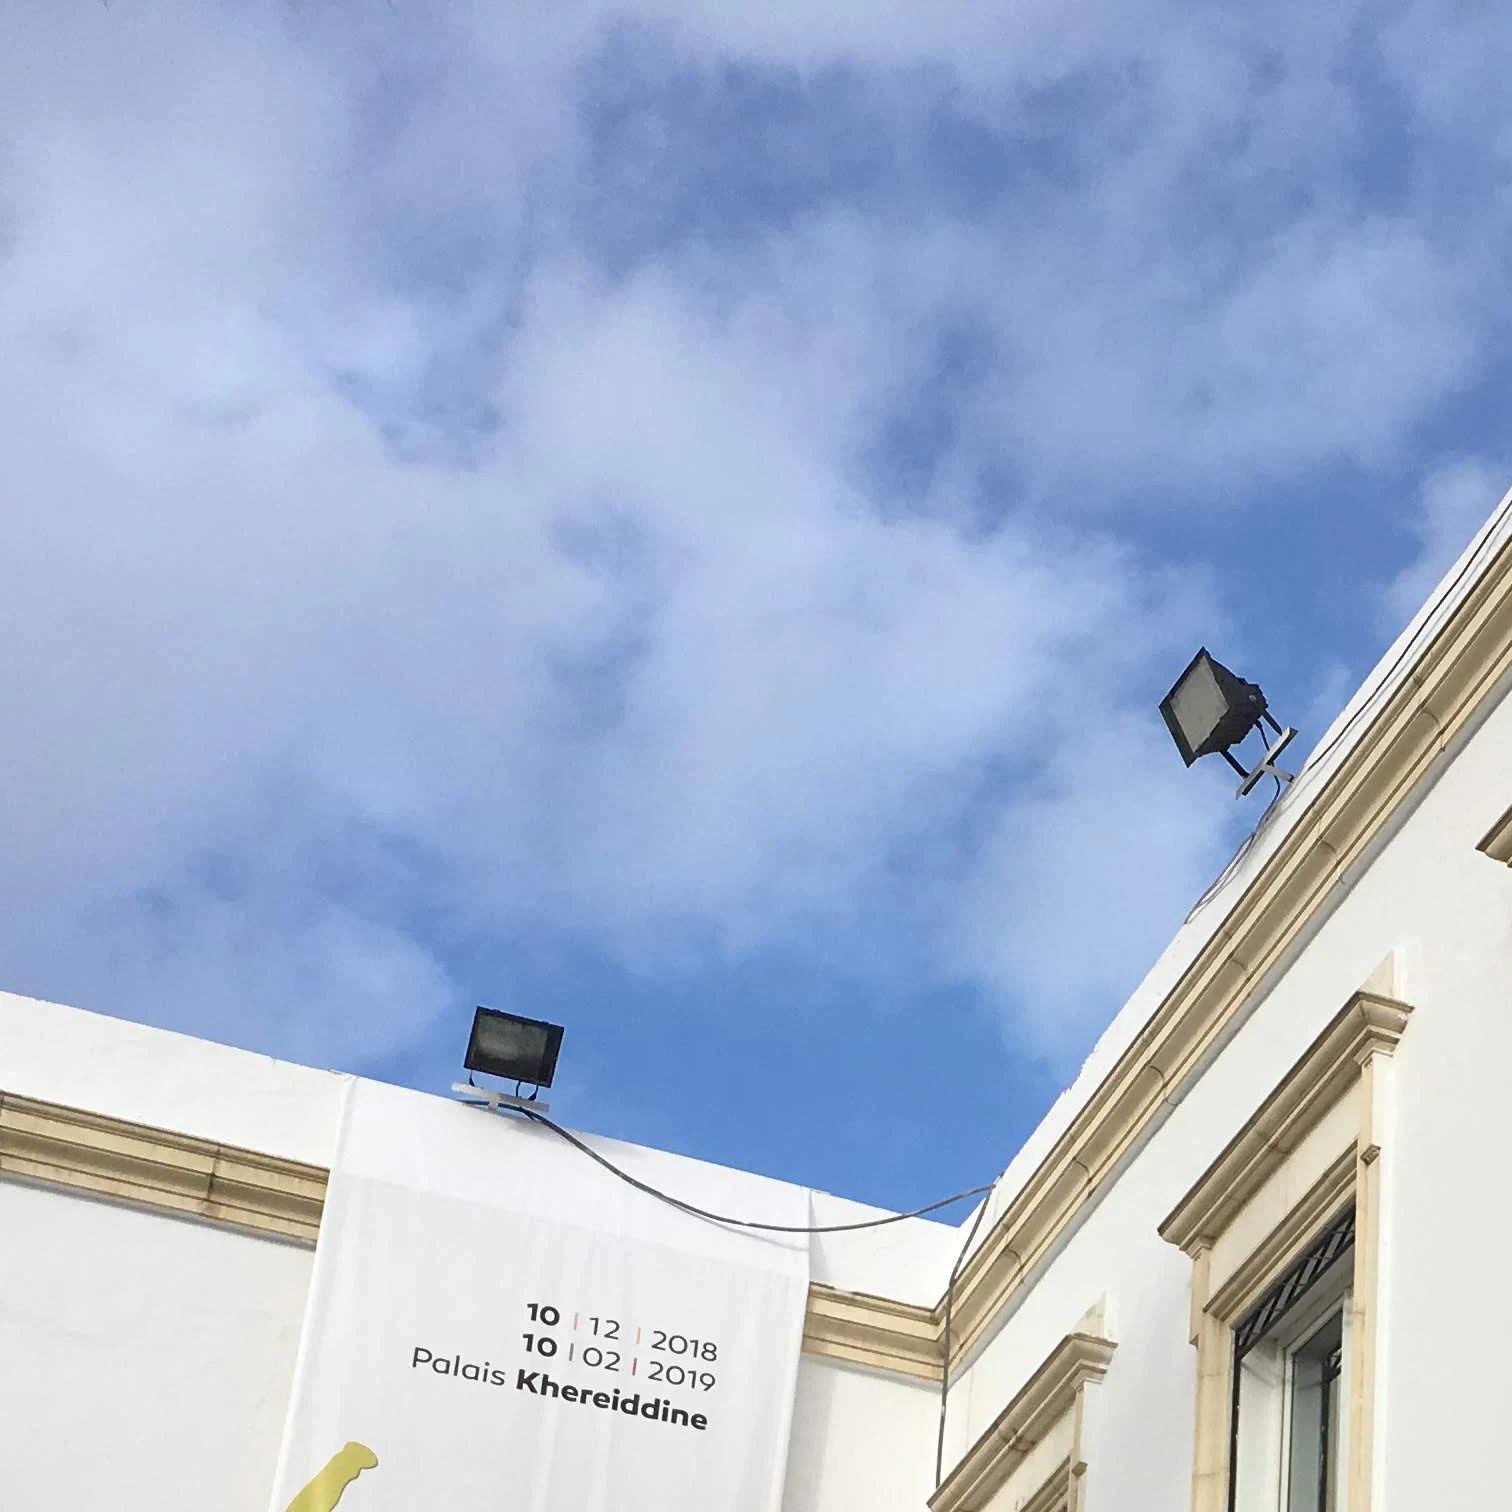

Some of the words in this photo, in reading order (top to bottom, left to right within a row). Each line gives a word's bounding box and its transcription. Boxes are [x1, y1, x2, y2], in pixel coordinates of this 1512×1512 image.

[527, 1303, 560, 1326] 10
[589, 1317, 620, 1340] 12
[651, 1330, 718, 1362] 2018
[412, 1346, 506, 1386] Palais
[516, 1368, 708, 1430] Khereiddine
[522, 1333, 557, 1357] 10
[583, 1347, 621, 1371] 02
[648, 1361, 716, 1392] 2019
